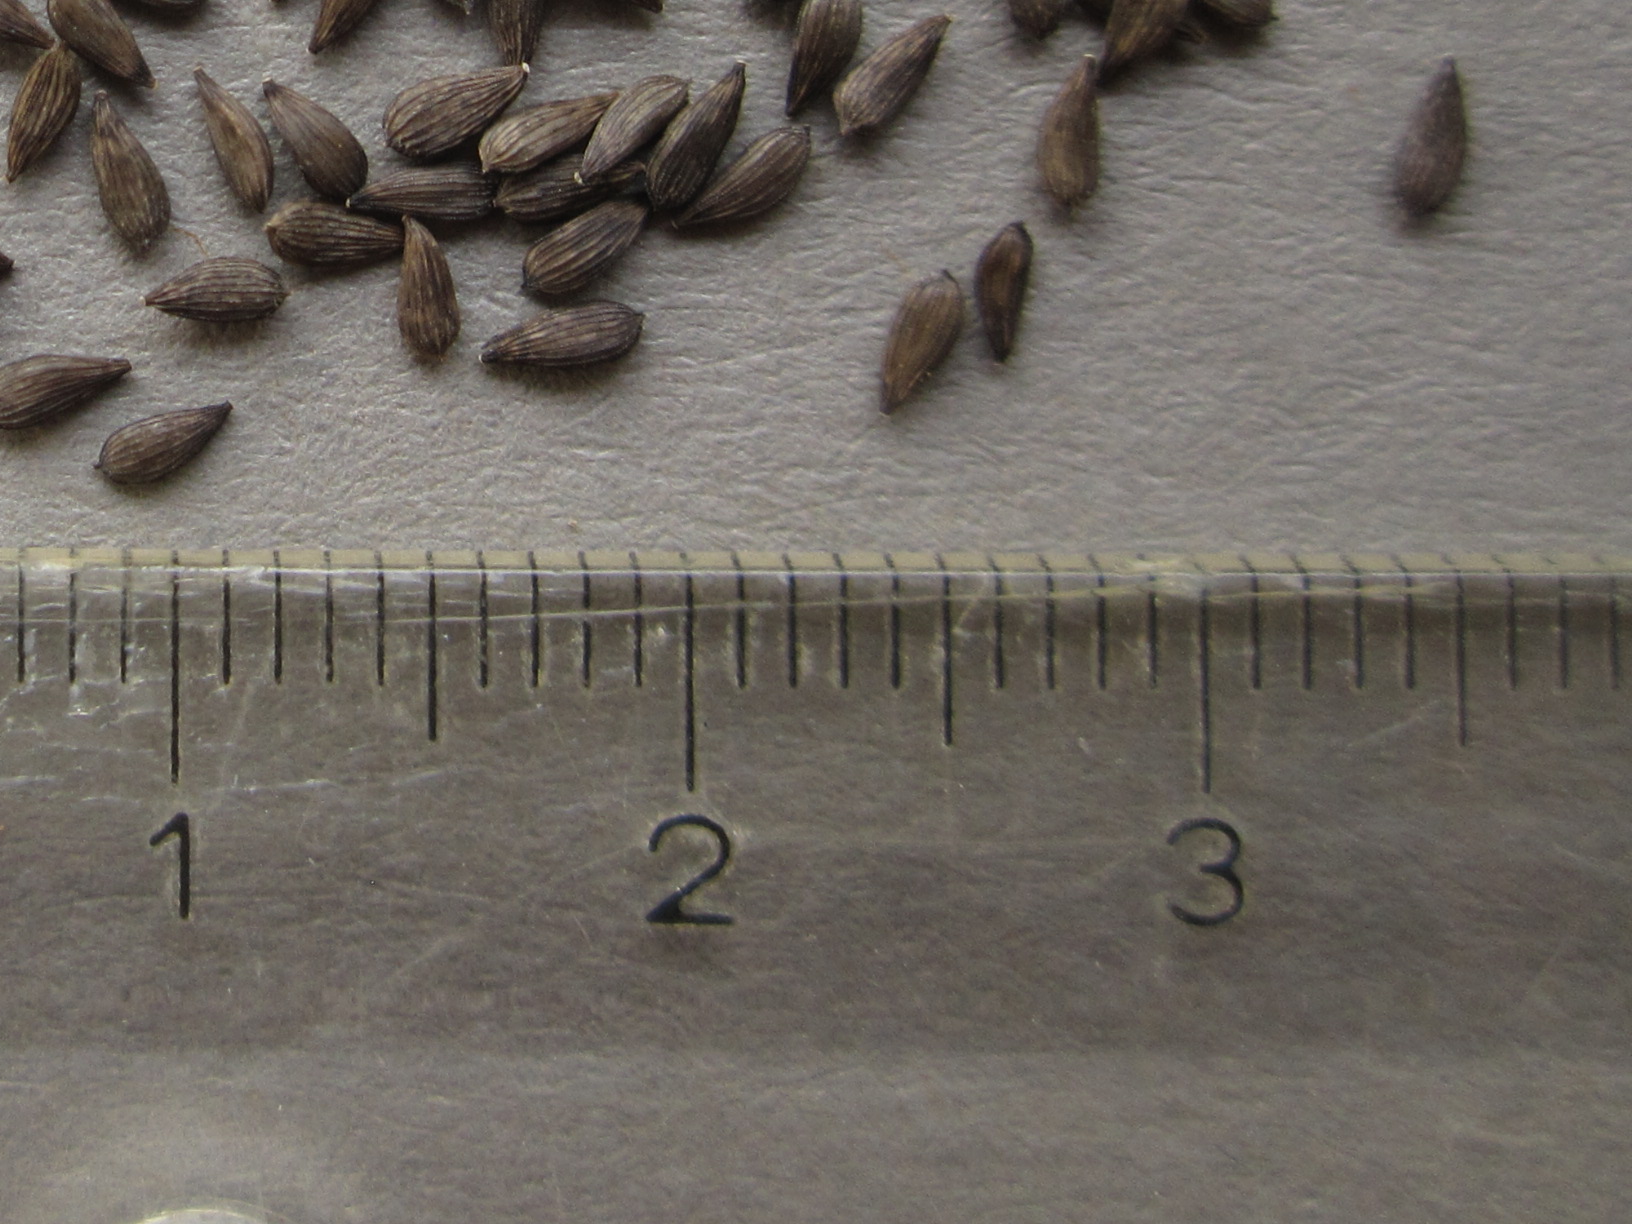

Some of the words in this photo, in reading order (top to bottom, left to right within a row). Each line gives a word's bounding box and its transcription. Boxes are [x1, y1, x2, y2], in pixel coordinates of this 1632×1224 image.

[148, 812, 192, 921] 1
[645, 813, 736, 926] 2
[1166, 816, 1246, 928] 3
